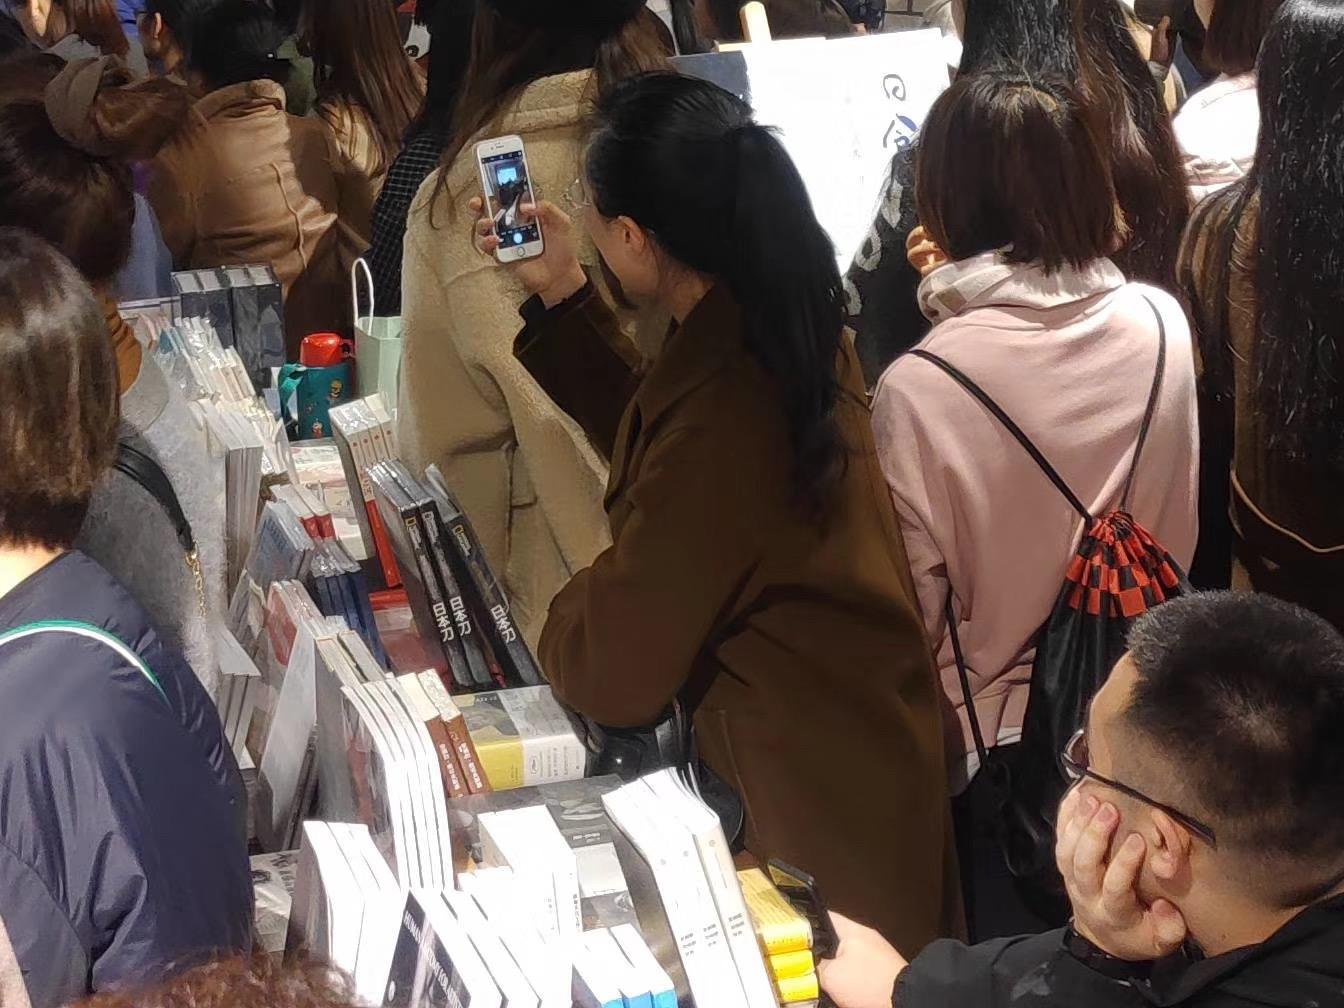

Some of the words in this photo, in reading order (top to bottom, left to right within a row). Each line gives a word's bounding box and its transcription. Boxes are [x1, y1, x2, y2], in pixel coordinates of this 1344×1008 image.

[433, 601, 454, 642] 日本刀
[449, 595, 471, 636] 日本刀
[490, 603, 516, 643] 日本刀
